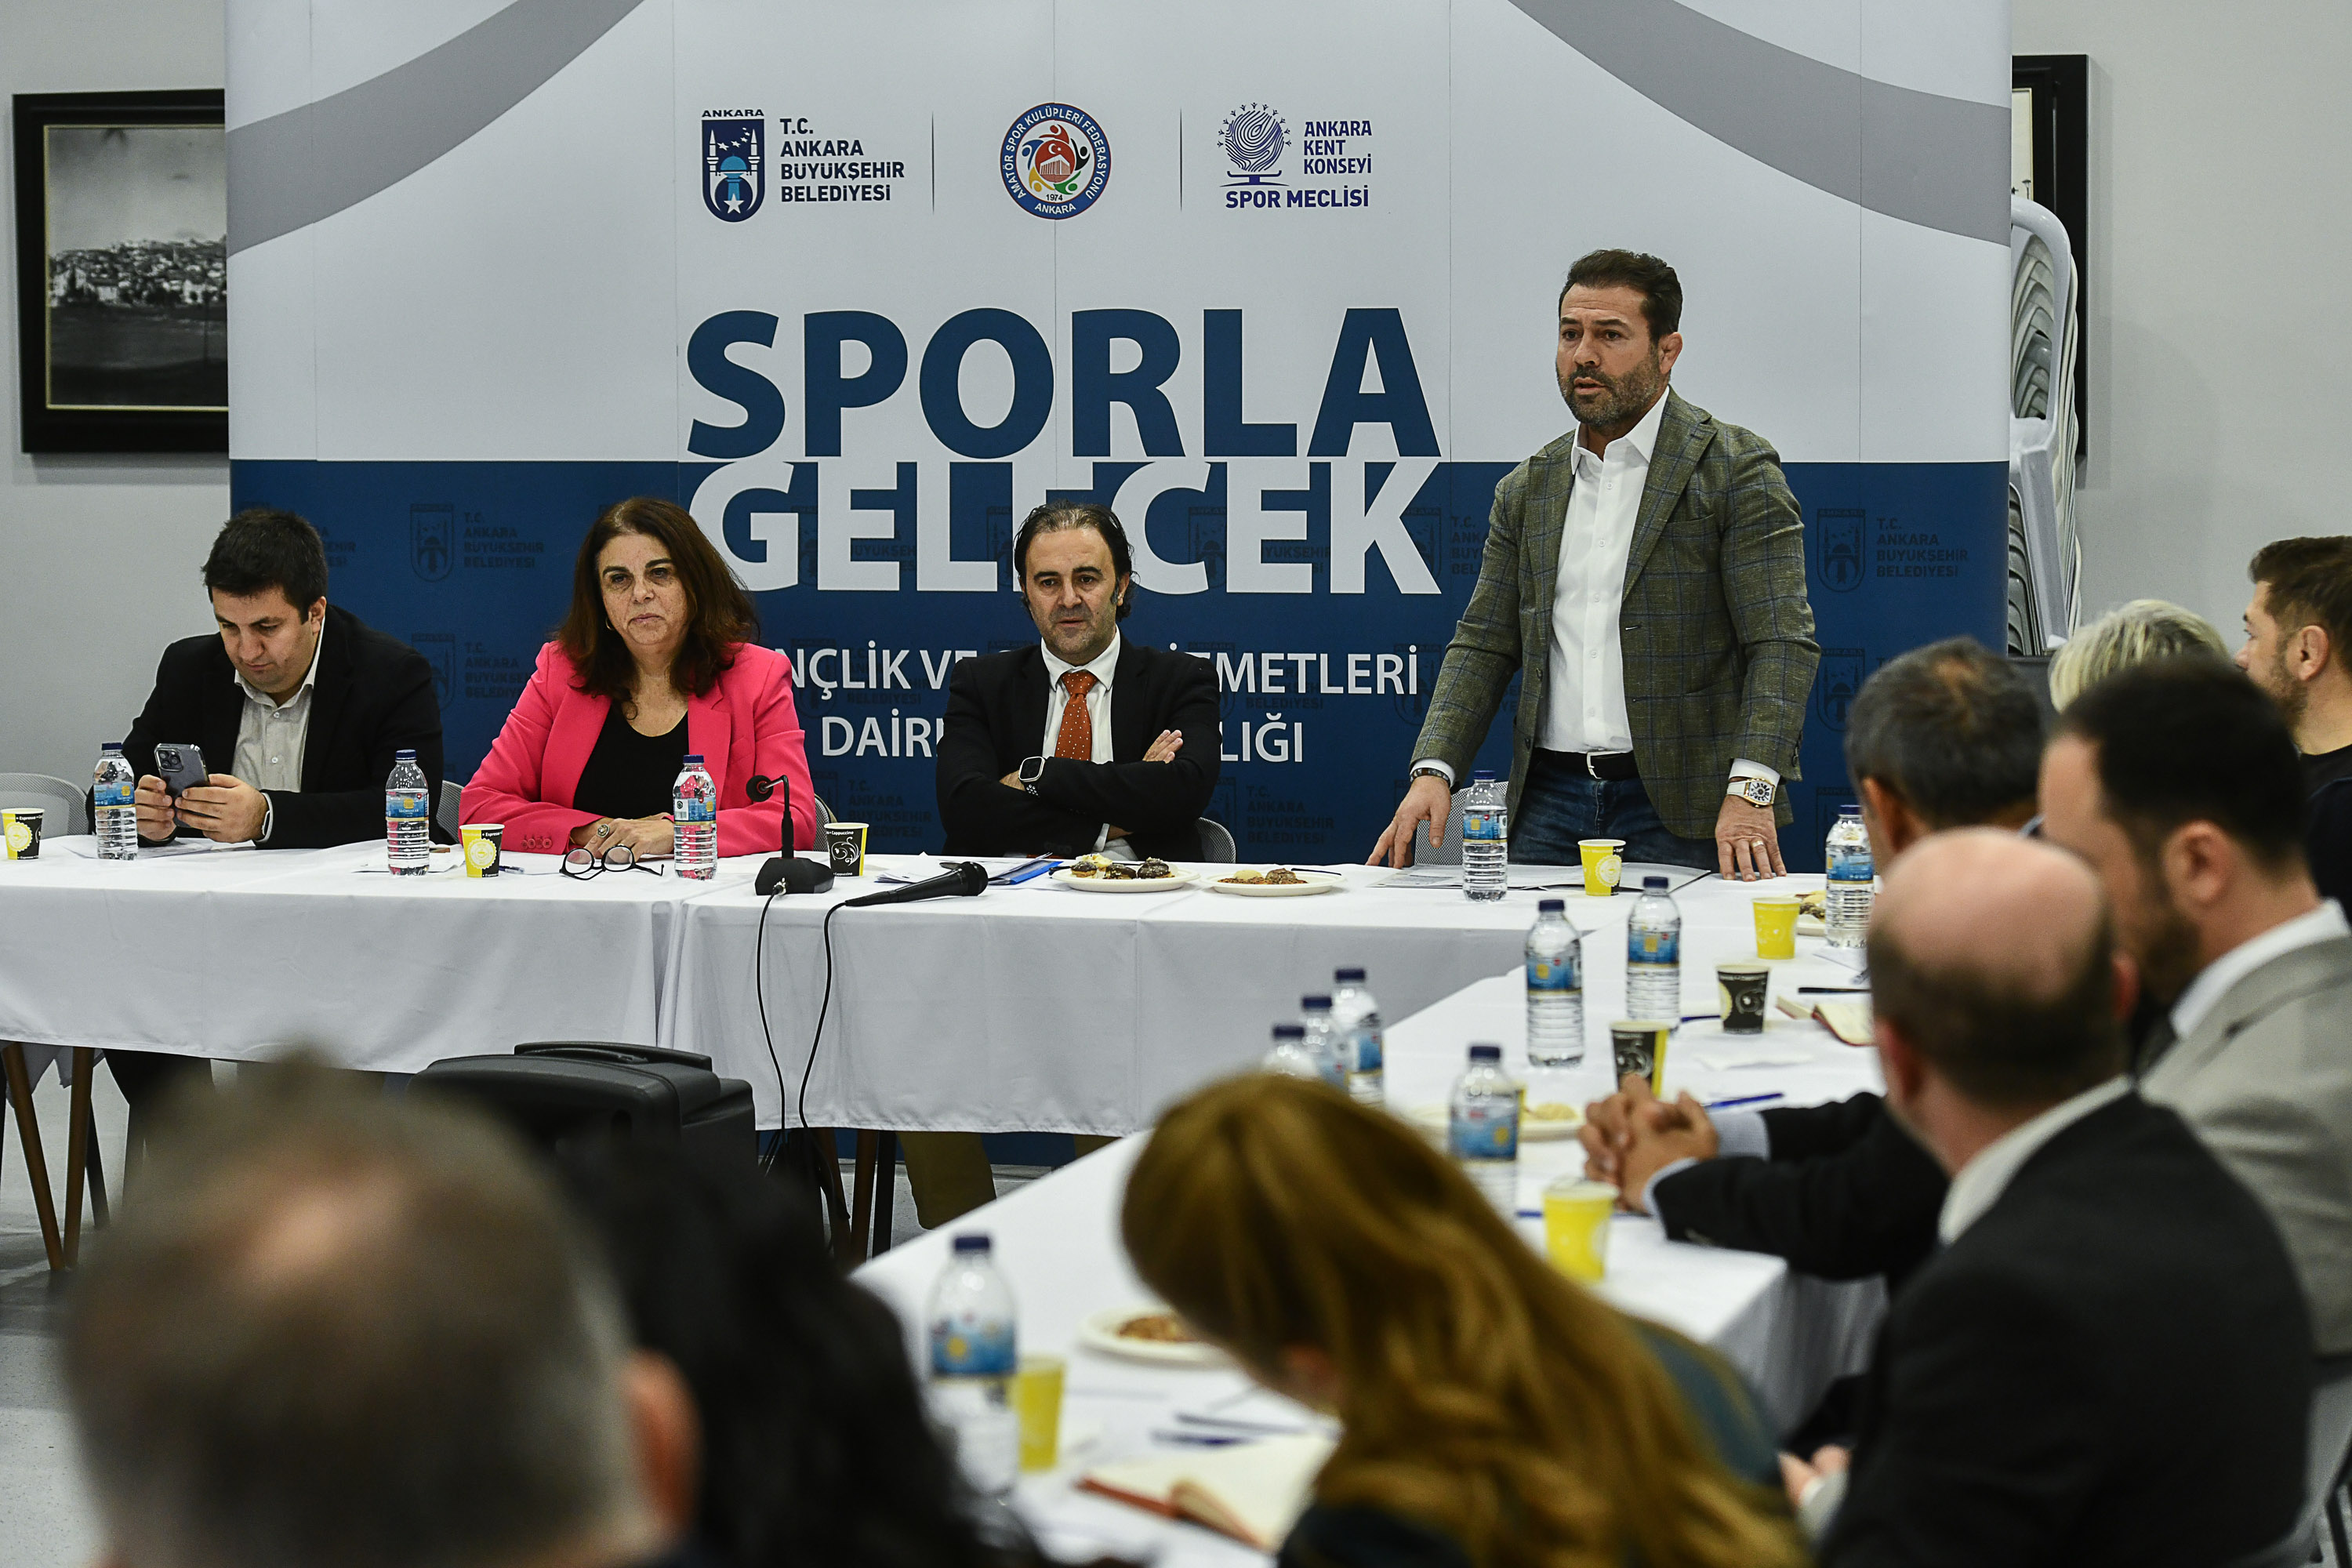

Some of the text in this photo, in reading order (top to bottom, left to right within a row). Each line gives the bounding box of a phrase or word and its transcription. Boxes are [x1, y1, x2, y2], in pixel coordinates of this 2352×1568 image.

[702, 109, 764, 118] ANKARA
[779, 118, 814, 134] T.C.
[1304, 120, 1373, 137] ANKARA
[780, 140, 864, 157] ANKARA
[1003, 105, 1107, 200] AMATÖR SPOR KULÜPLERİ FEDERASYONU
[1303, 140, 1346, 156] KENT
[781, 162, 905, 181] BÜYÜKŞEHİR
[1303, 153, 1372, 174] KONSEYİ
[781, 184, 891, 202] BELEDİYESİ
[1046, 193, 1063, 201] 1974
[1225, 185, 1369, 209] SPOR MECLİSİ
[1034, 202, 1076, 215] ANKARA
[687, 307, 1442, 459] SPORLA
[1876, 533, 1940, 546] ANKARA
[775, 641, 1417, 700] NÇLİK V METLERİ
[822, 708, 945, 758] DAİR
